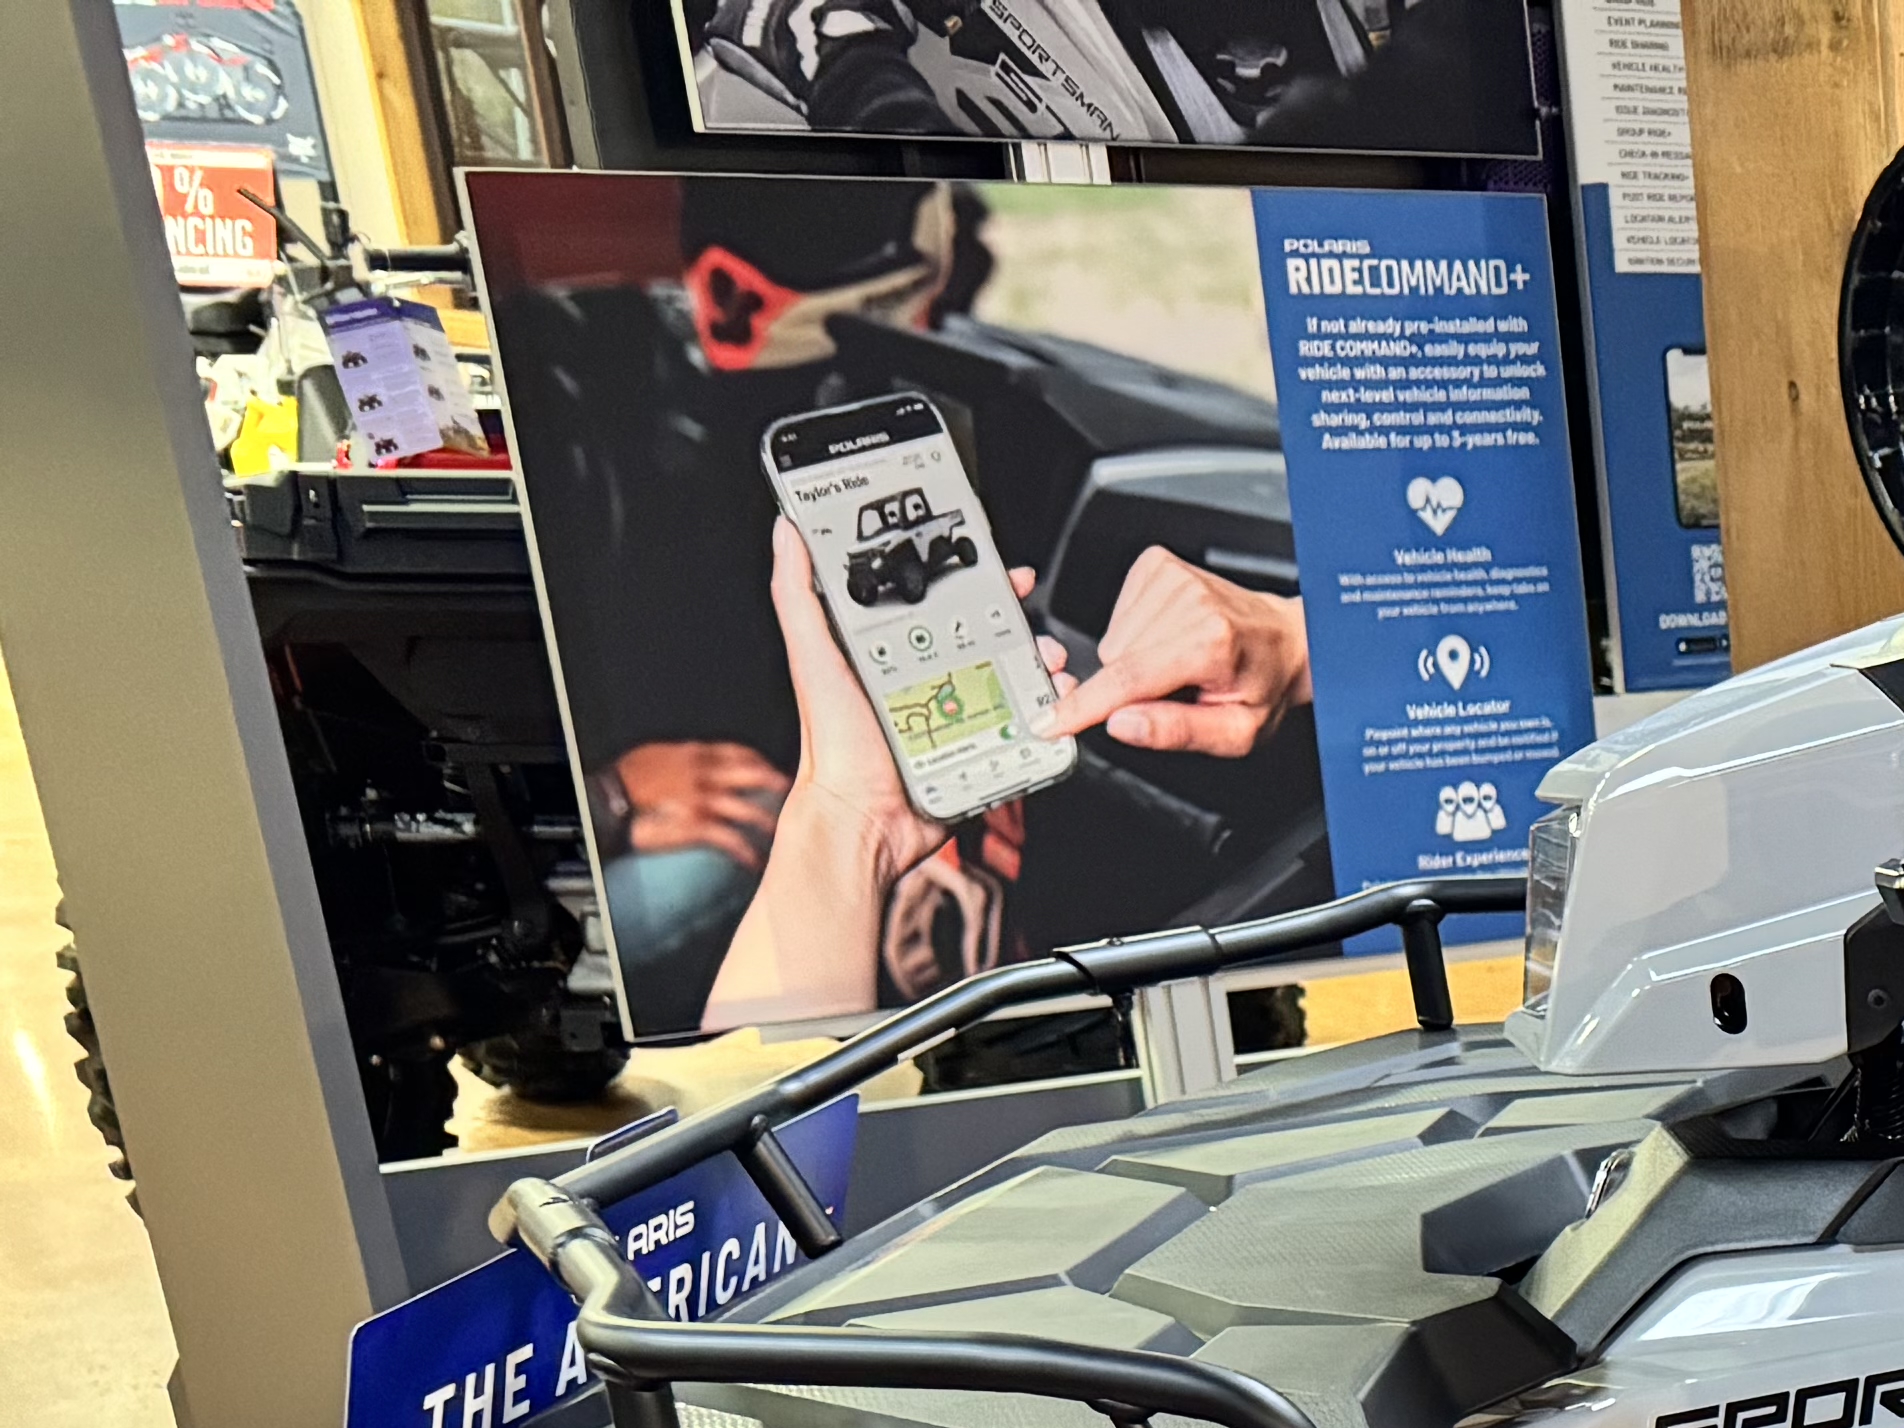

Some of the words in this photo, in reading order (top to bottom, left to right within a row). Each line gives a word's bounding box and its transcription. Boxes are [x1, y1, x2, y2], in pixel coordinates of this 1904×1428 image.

[1284, 239, 1371, 255] POLARIS
[1286, 258, 1531, 296] RIDECOMMAND+
[1320, 316, 1345, 334] not
[1348, 316, 1401, 338] already
[1404, 316, 1495, 338] pre-installed
[1497, 315, 1529, 333] with
[1298, 339, 1334, 357] RIDE
[1424, 339, 1465, 360] easily
[1467, 338, 1507, 359] equip
[1508, 341, 1540, 359] your
[1298, 362, 1351, 380] vehicle
[1353, 362, 1386, 380] with
[1387, 366, 1407, 379] an
[1408, 366, 1481, 382] accessory
[1482, 363, 1498, 378] to
[1499, 361, 1546, 379] unlock
[1321, 386, 1395, 403] next-level
[1396, 385, 1448, 403] vehicle
[1449, 383, 1531, 402] information
[1311, 408, 1370, 429] sharing,
[1372, 408, 1425, 426] control
[1426, 407, 1453, 426] and
[828, 430, 891, 455] POLARIS
[1321, 432, 1388, 449] Available
[1388, 431, 1411, 448] for
[1412, 434, 1432, 450] up
[1433, 432, 1450, 448] to
[795, 480, 842, 503] Taylor's
[842, 474, 870, 490] Ride
[1393, 547, 1445, 565] Vehicle
[1446, 546, 1492, 563] Health
[1402, 604, 1439, 616] vehicle
[1406, 701, 1456, 720] Vehicle
[1457, 699, 1511, 718] Locator
[1462, 721, 1498, 733] vehicle
[1418, 853, 1454, 870] Rider
[1455, 847, 1530, 869] Experience
